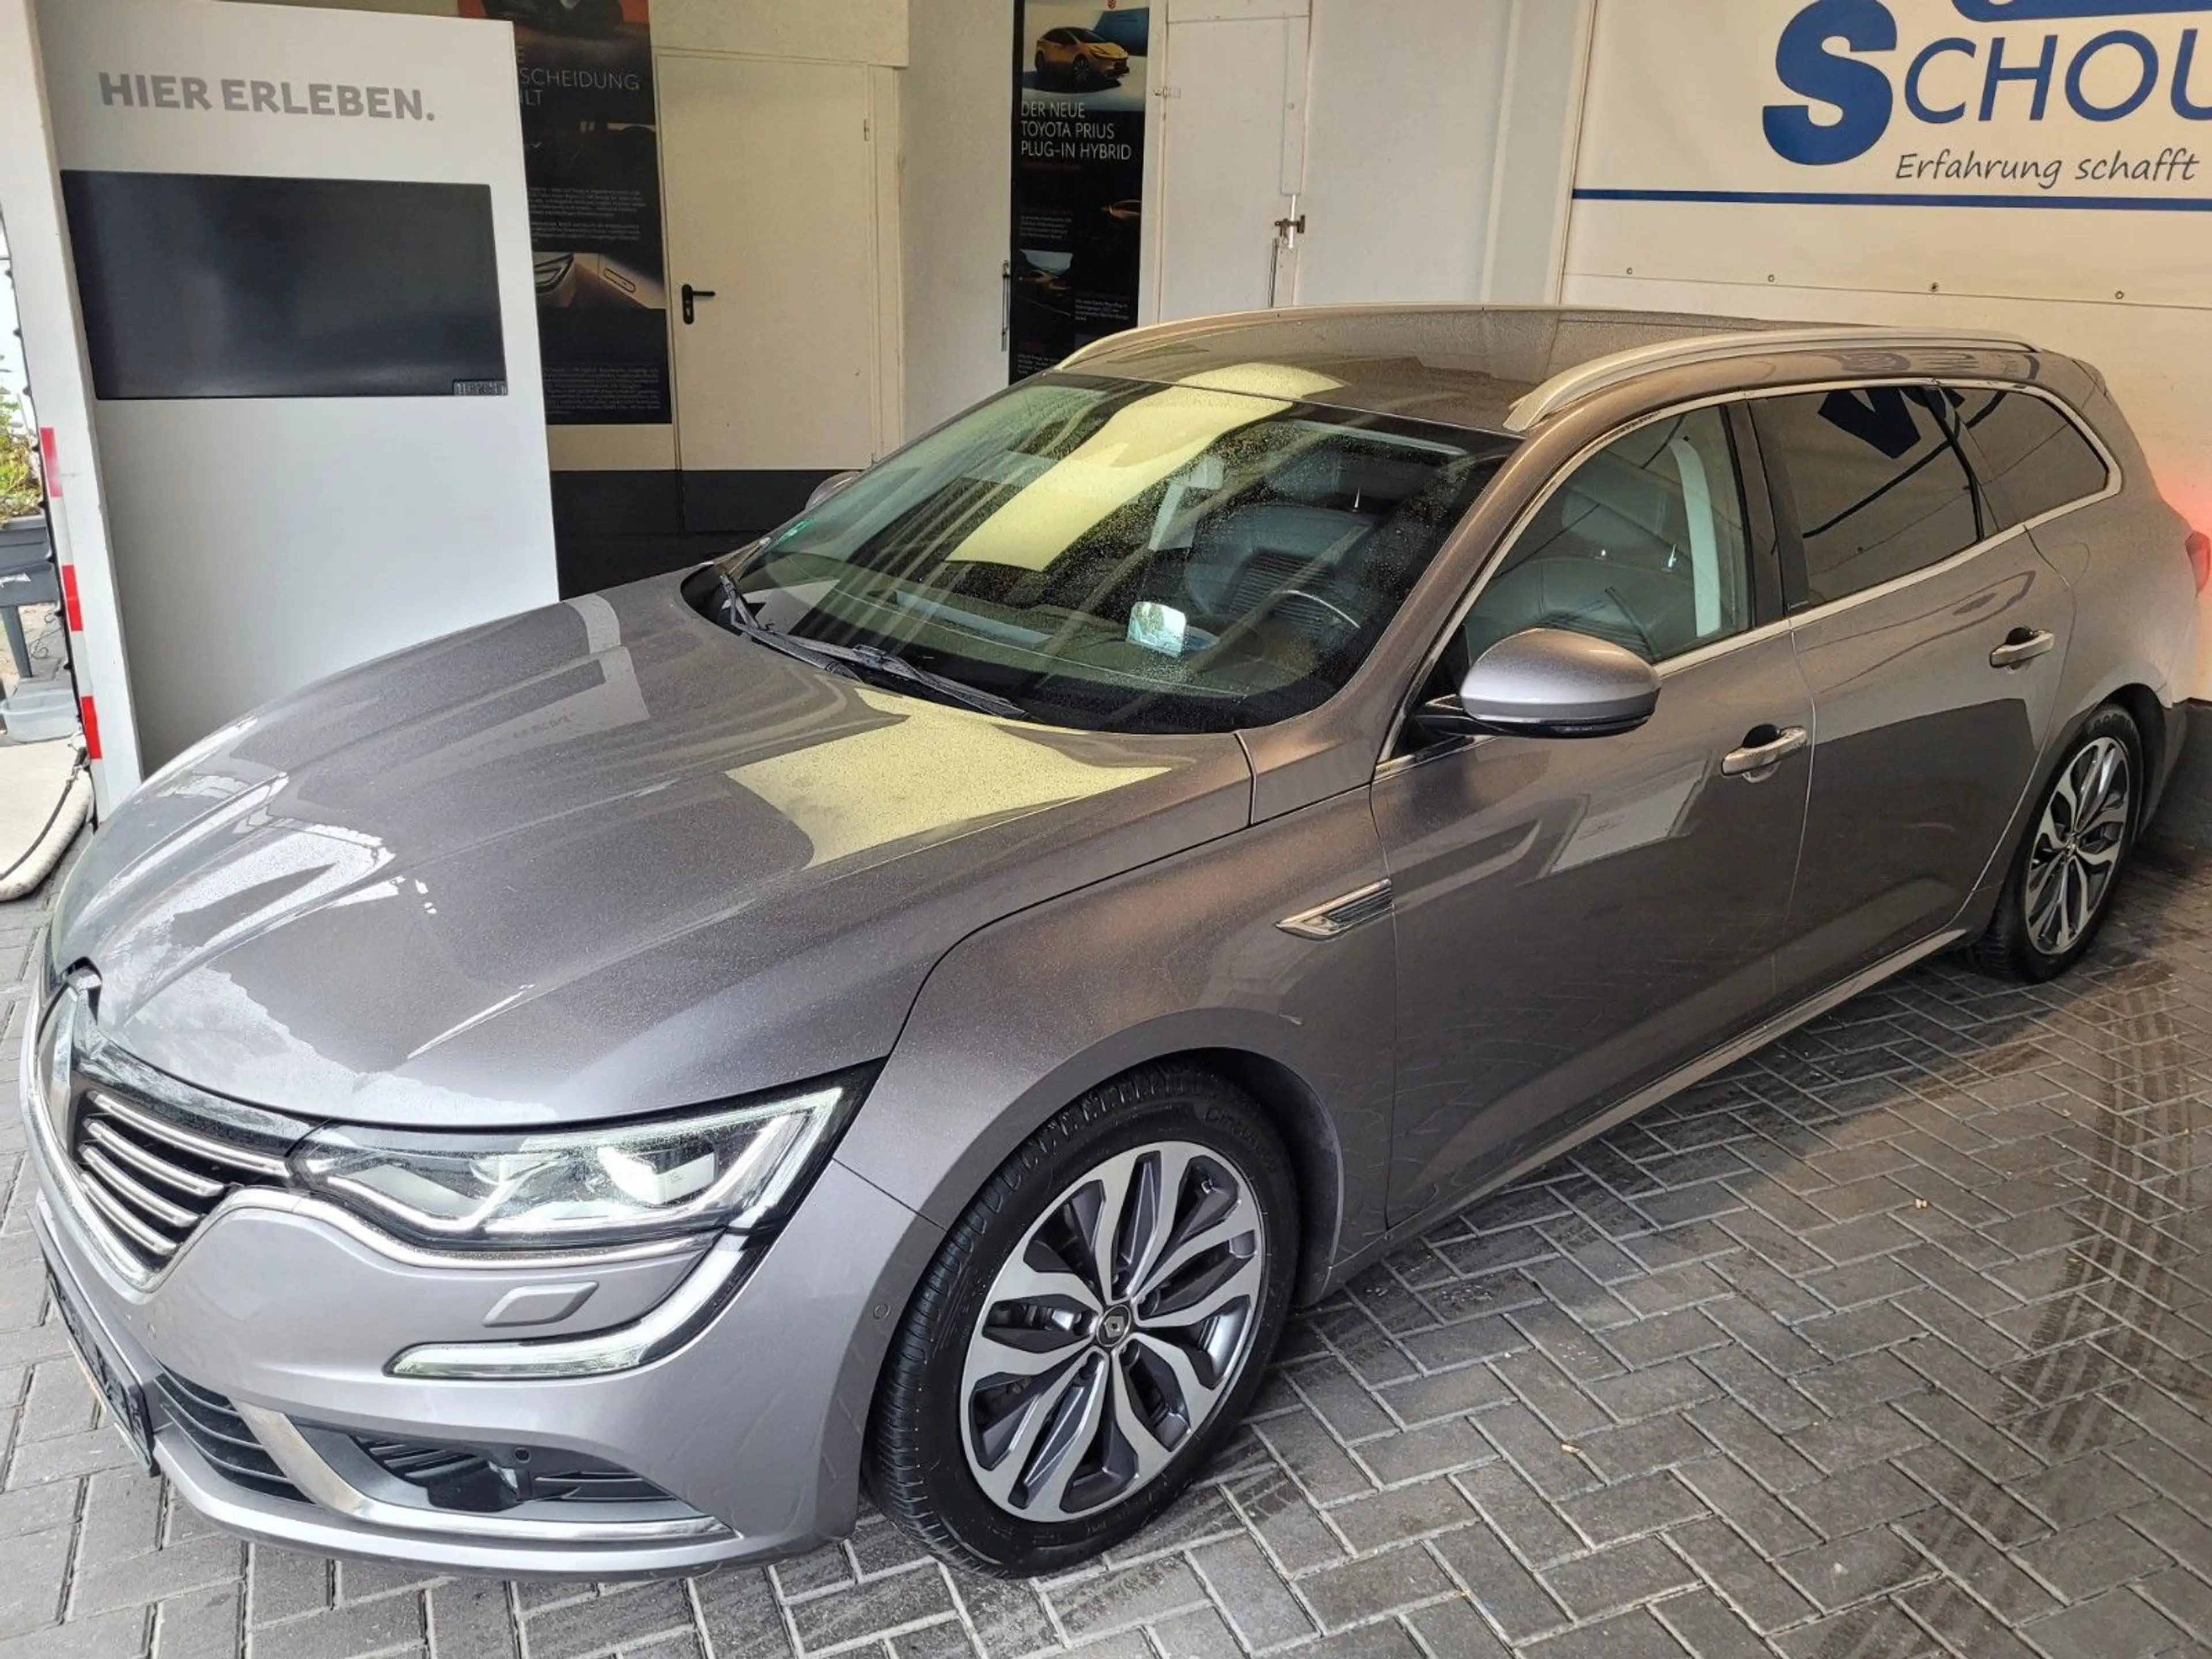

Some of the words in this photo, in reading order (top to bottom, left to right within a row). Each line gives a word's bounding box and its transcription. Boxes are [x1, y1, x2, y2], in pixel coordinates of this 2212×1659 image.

[520, 67, 639, 90] SCHEIDUNG
[99, 71, 213, 111] HIER
[221, 78, 435, 121] ERLEBEN.
[1021, 101, 1046, 118] DER
[1050, 101, 1086, 119] NEUE
[1021, 120, 1071, 138] TOYOTA
[1075, 122, 1115, 139] PRIUS
[1021, 140, 1075, 158] PLUG-IN
[1080, 143, 1132, 161] HYBRID
[1895, 148, 2063, 189] Erfahrung
[2075, 147, 2200, 182] schafft
